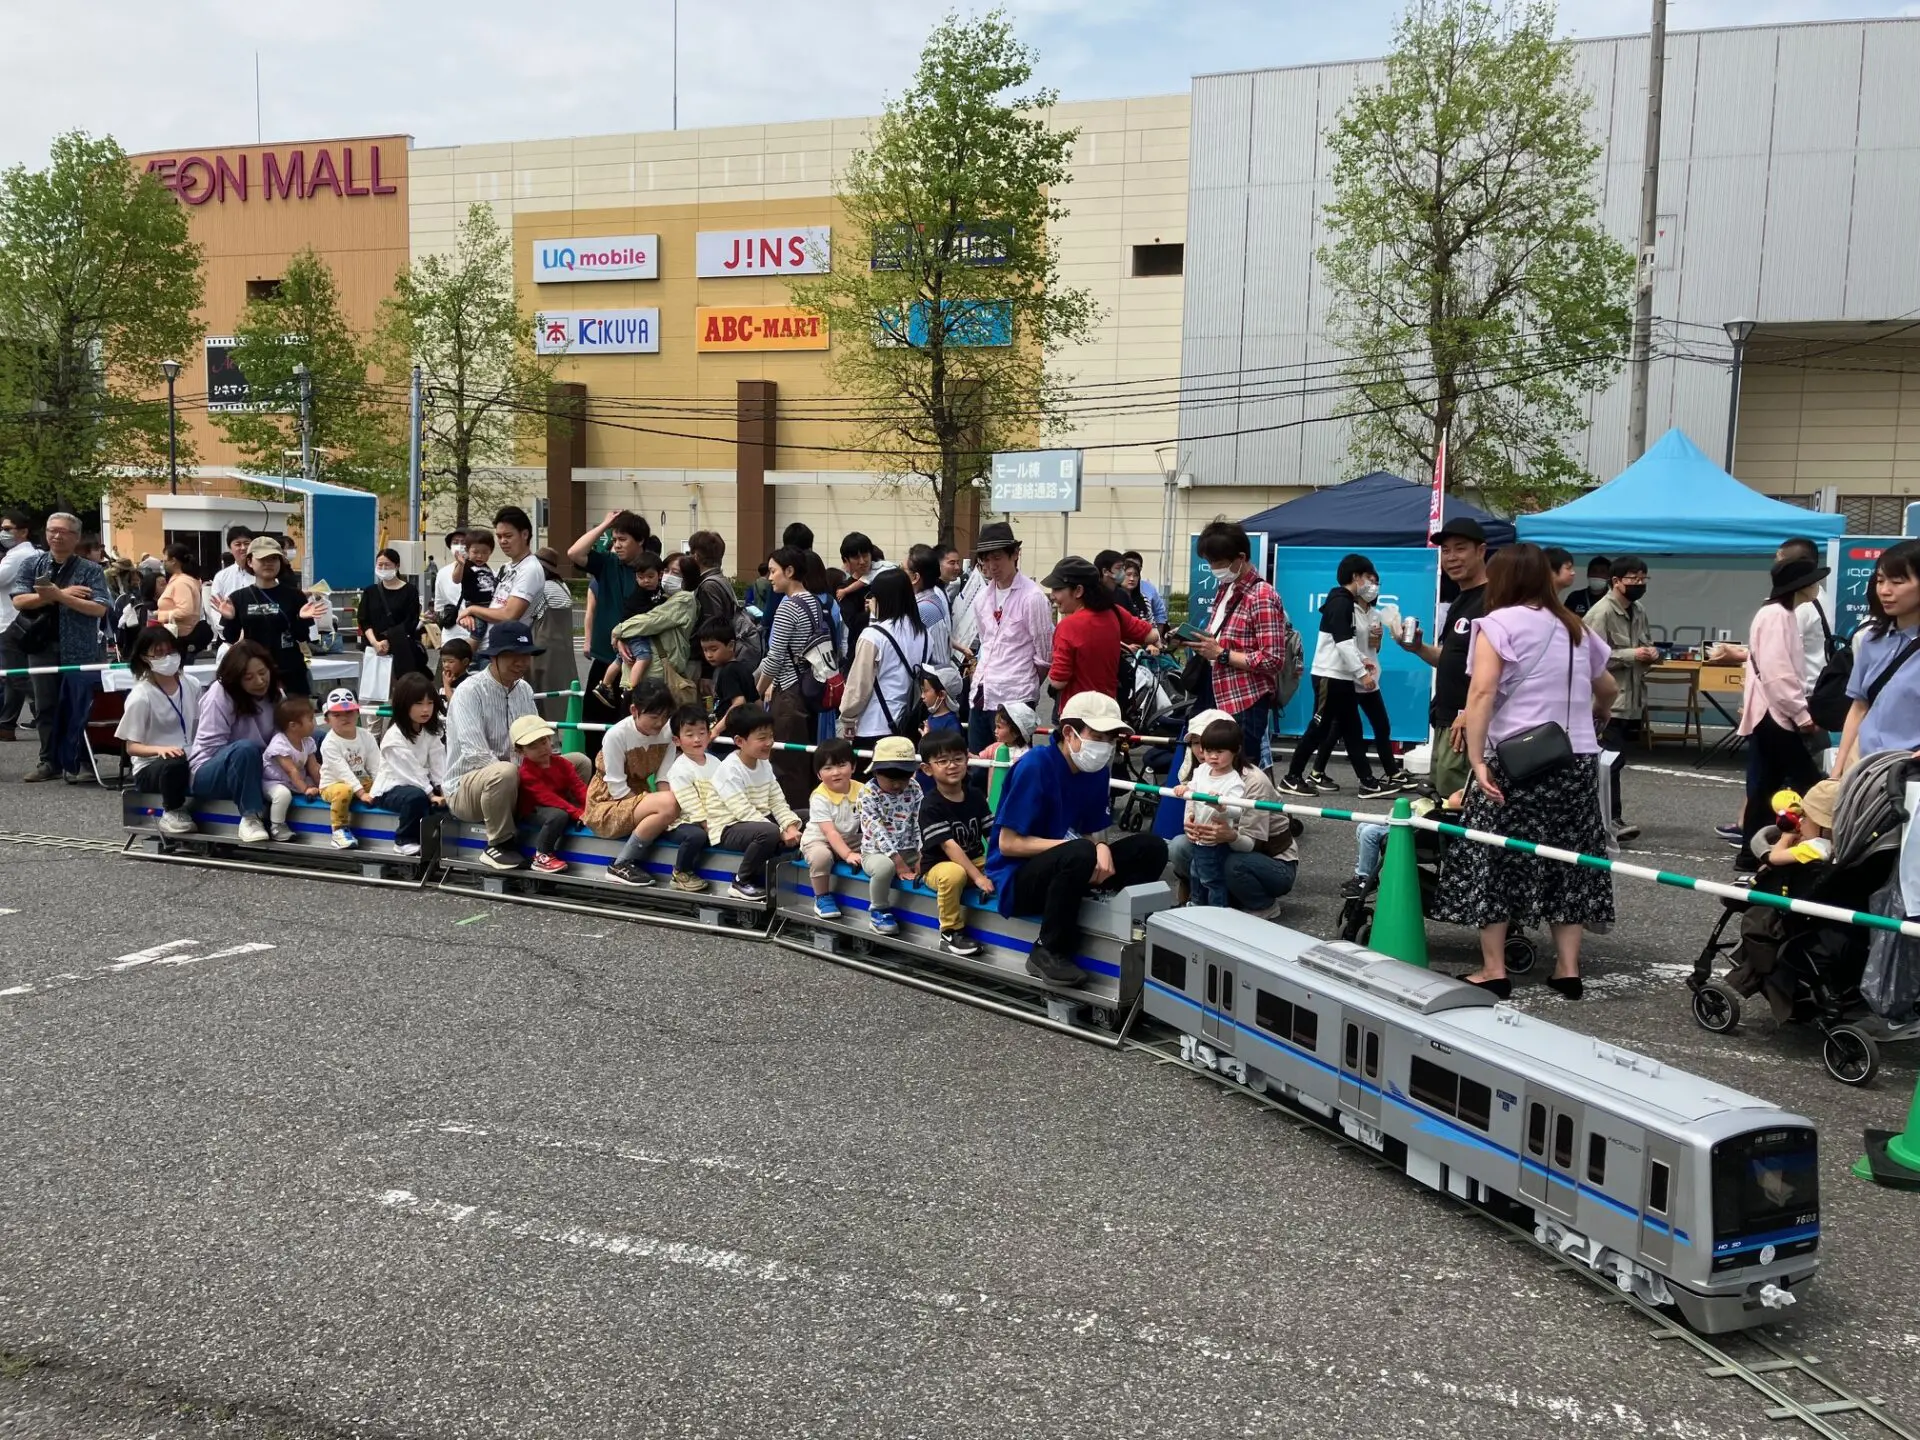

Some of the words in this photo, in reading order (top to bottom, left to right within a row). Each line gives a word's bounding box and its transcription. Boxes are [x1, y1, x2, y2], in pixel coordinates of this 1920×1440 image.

[262, 145, 397, 200] MALL
[543, 248, 575, 271] UQ
[579, 247, 646, 268] mobile
[704, 316, 820, 342] ABC-MART
